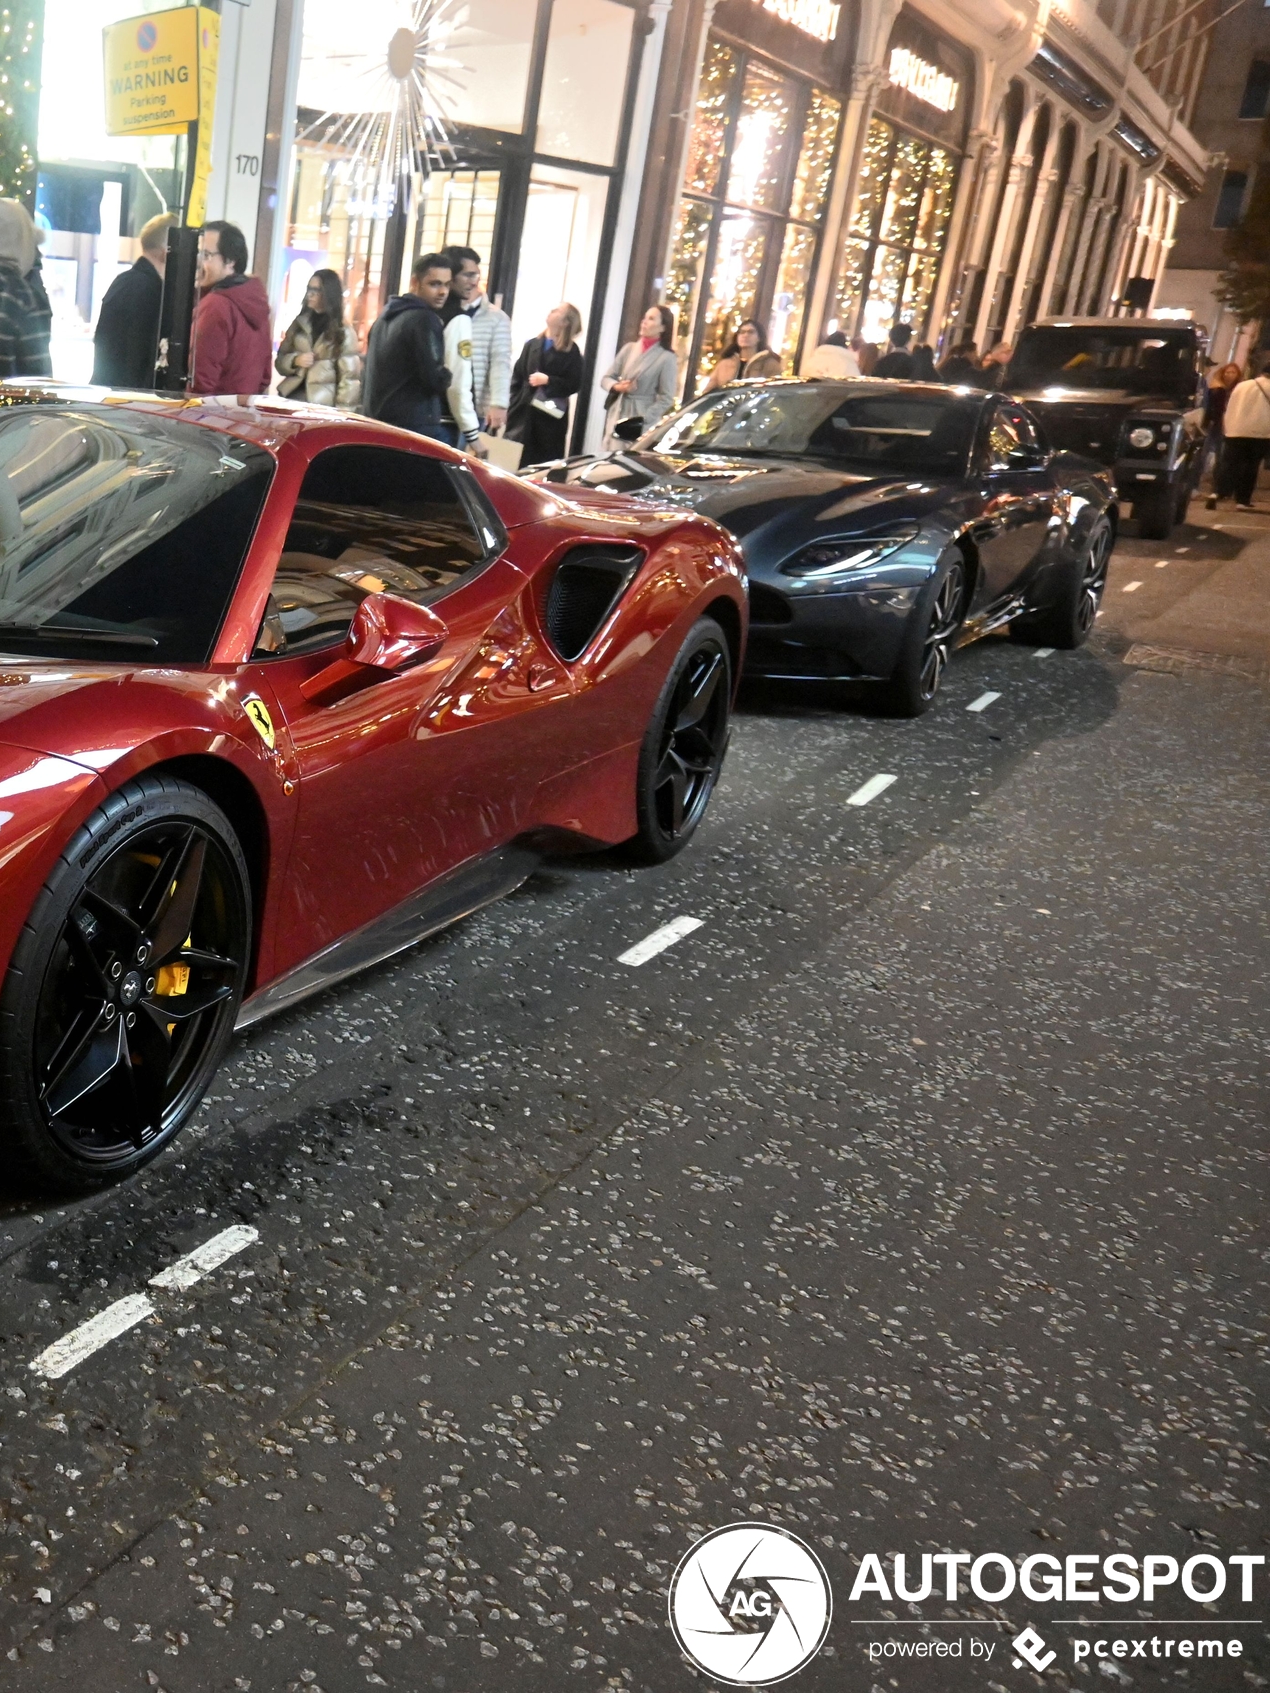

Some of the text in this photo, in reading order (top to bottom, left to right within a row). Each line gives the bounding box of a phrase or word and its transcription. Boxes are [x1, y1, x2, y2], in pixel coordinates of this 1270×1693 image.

[123, 54, 173, 71] at any time
[111, 65, 190, 95] WARNING
[130, 94, 167, 108] Parking
[123, 109, 176, 125] suspension
[235, 154, 259, 177] 170
